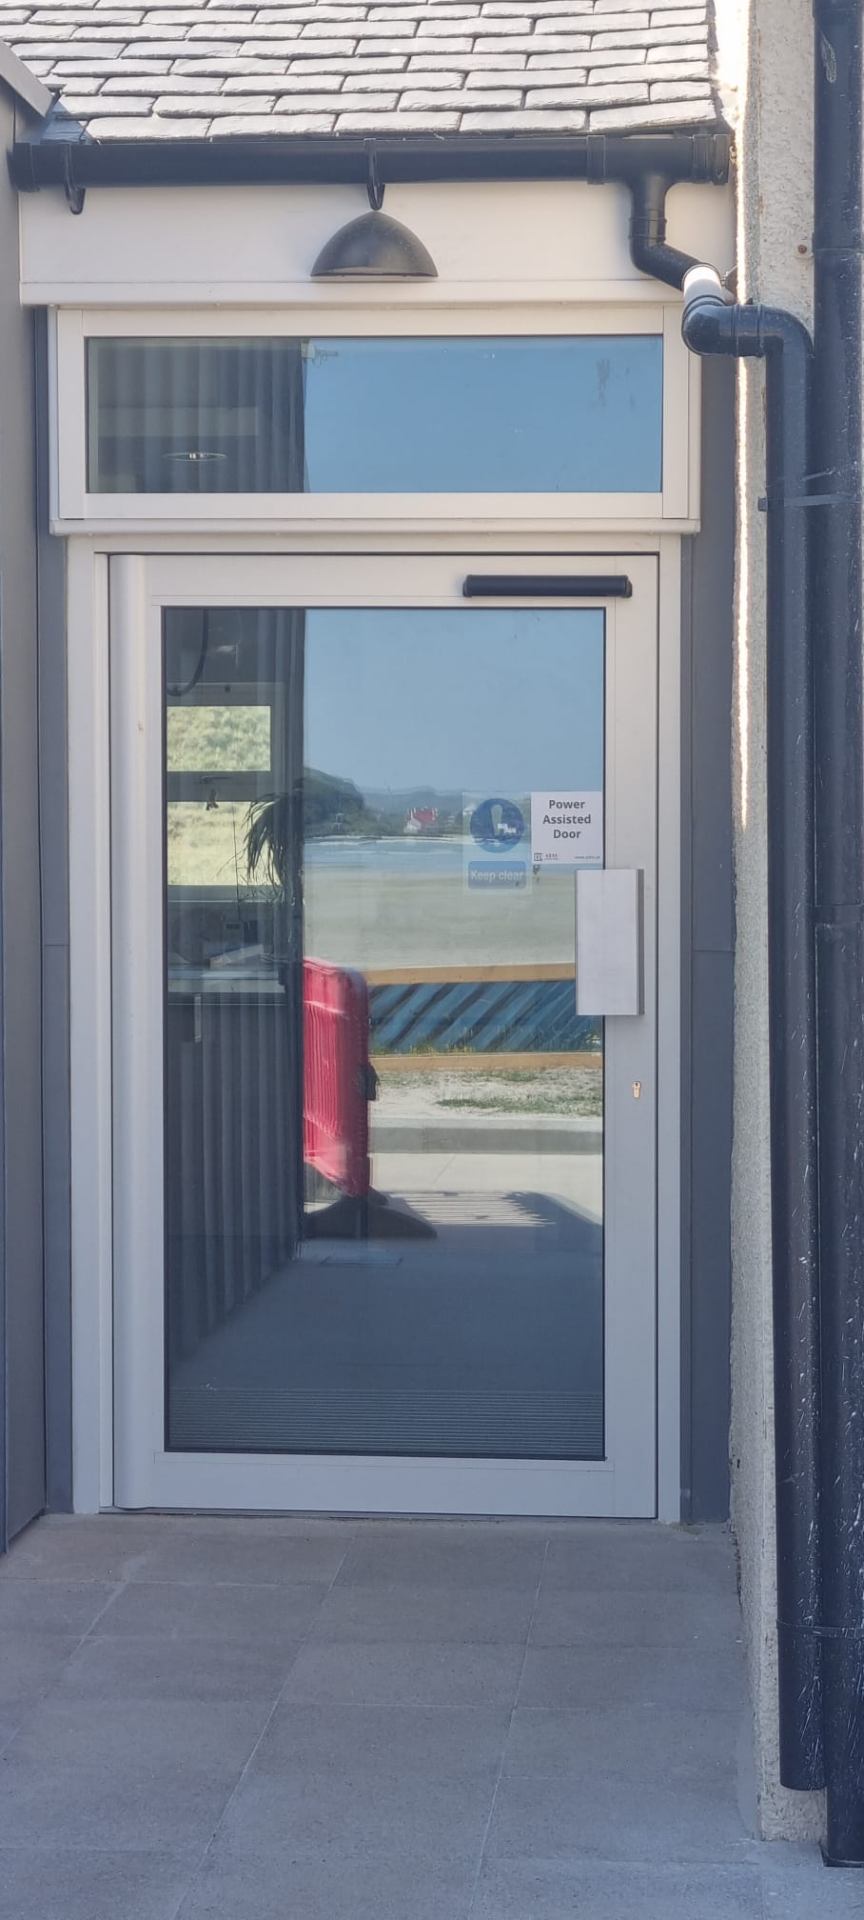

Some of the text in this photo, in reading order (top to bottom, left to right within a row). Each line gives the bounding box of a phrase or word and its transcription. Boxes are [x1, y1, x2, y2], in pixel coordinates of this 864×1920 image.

[549, 799, 585, 809] Power
[543, 814, 591, 824] Assisted
[553, 829, 581, 839] Door
[471, 870, 524, 883] Keep clear
